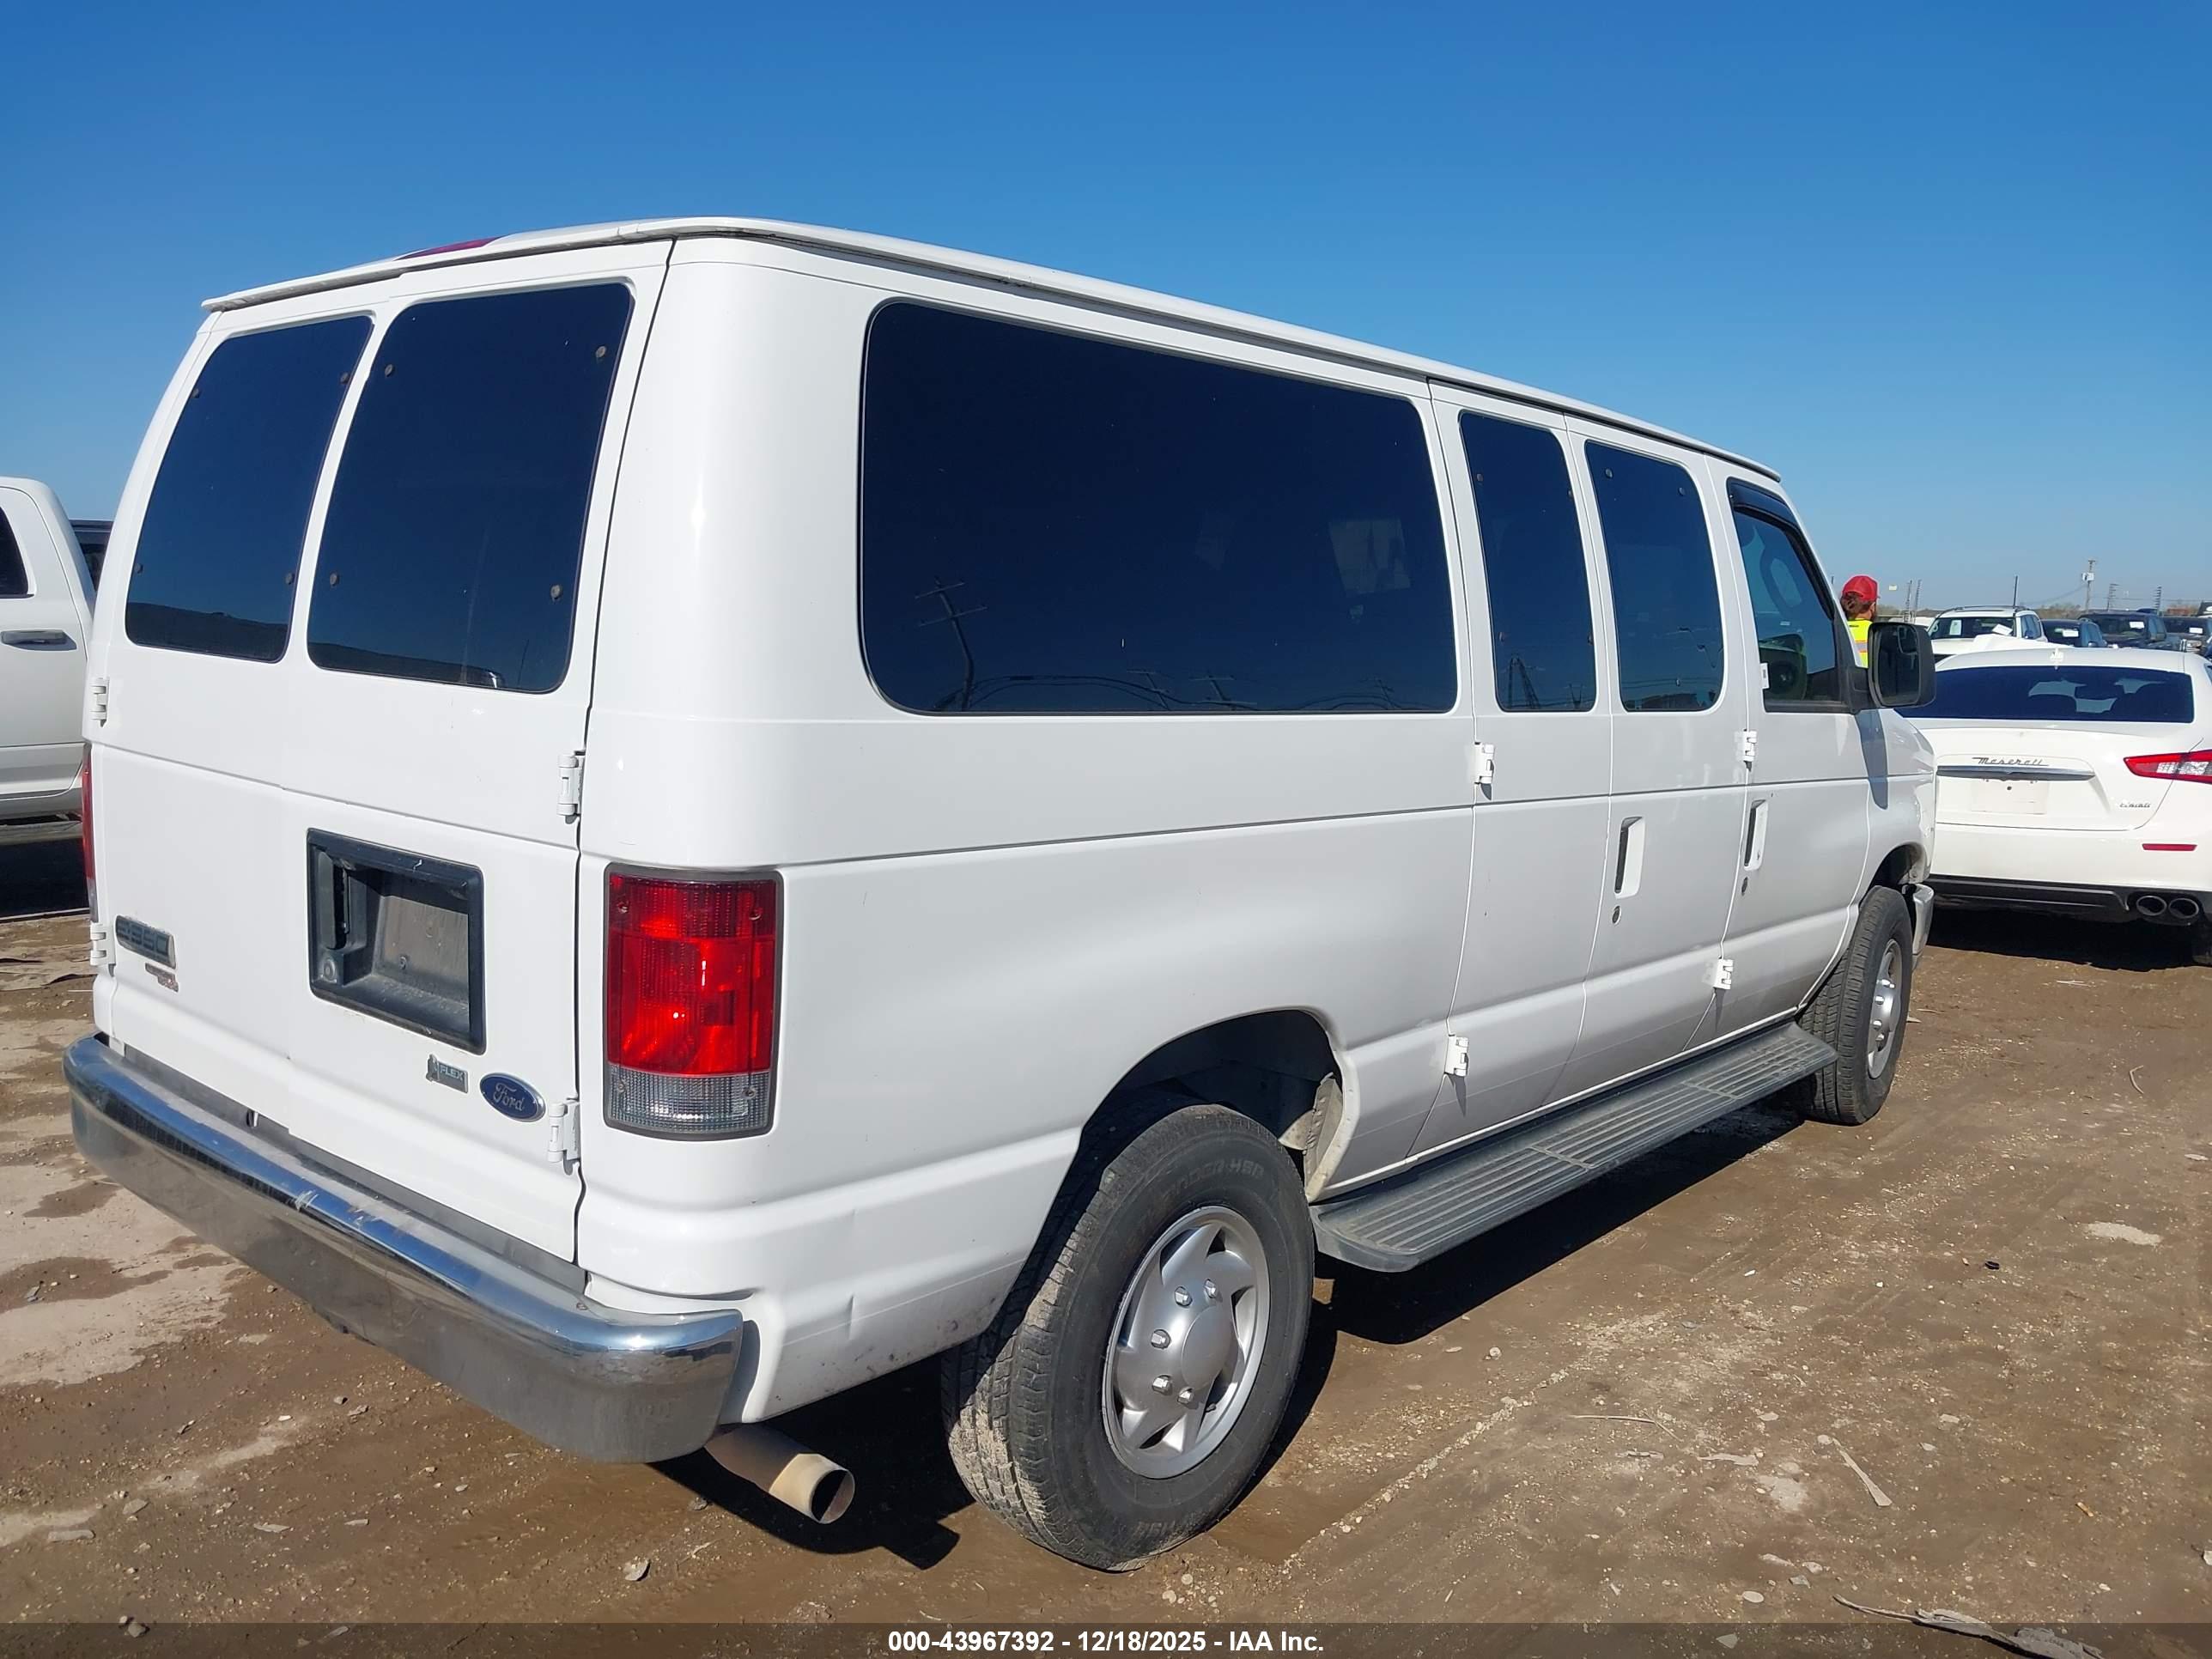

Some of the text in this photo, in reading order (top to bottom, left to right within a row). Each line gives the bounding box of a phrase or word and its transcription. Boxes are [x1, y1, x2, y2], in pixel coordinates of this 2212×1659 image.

[1972, 757, 2050, 767] Maserati
[440, 1064, 464, 1082] FLEX
[492, 1082, 526, 1112] Ford
